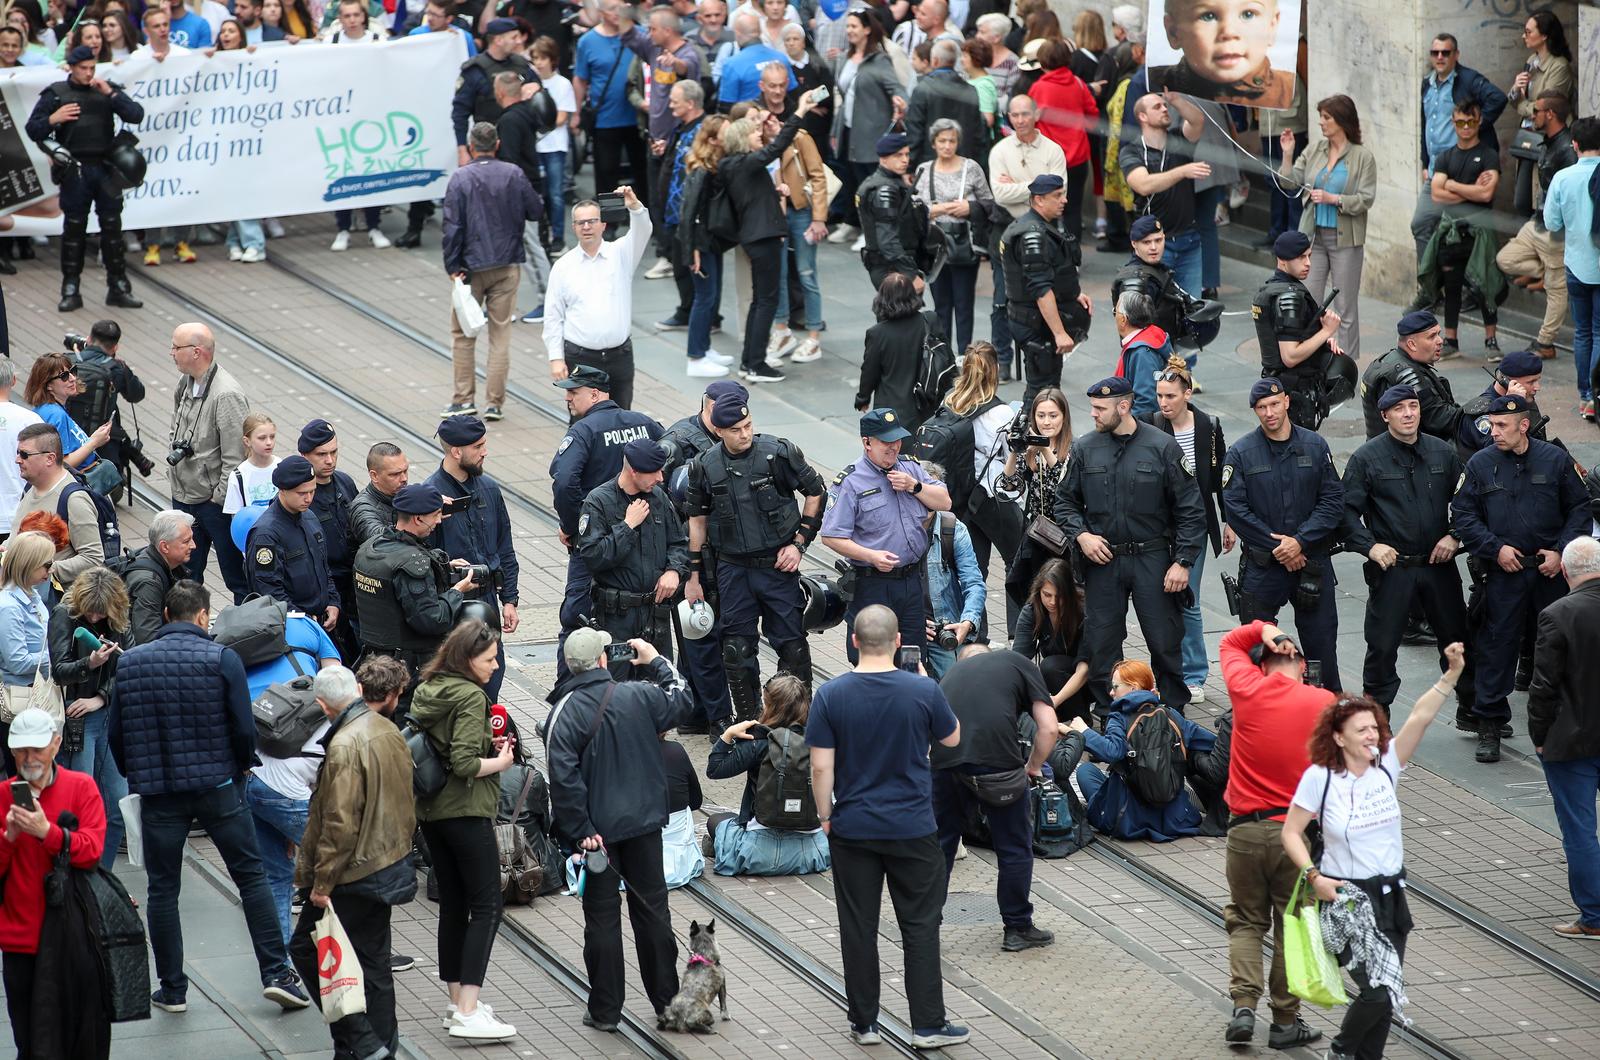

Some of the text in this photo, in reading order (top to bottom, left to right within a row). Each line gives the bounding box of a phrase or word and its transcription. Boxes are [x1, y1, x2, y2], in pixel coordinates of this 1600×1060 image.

[133, 60, 279, 99] zaustavljaj
[211, 102, 283, 128] moga
[291, 89, 353, 119] srca!
[177, 132, 220, 166] daj
[229, 129, 264, 157] mi
[316, 111, 423, 163] HOD
[324, 148, 430, 179] ZA ŽIVOT
[603, 425, 650, 447] POLICIJA
